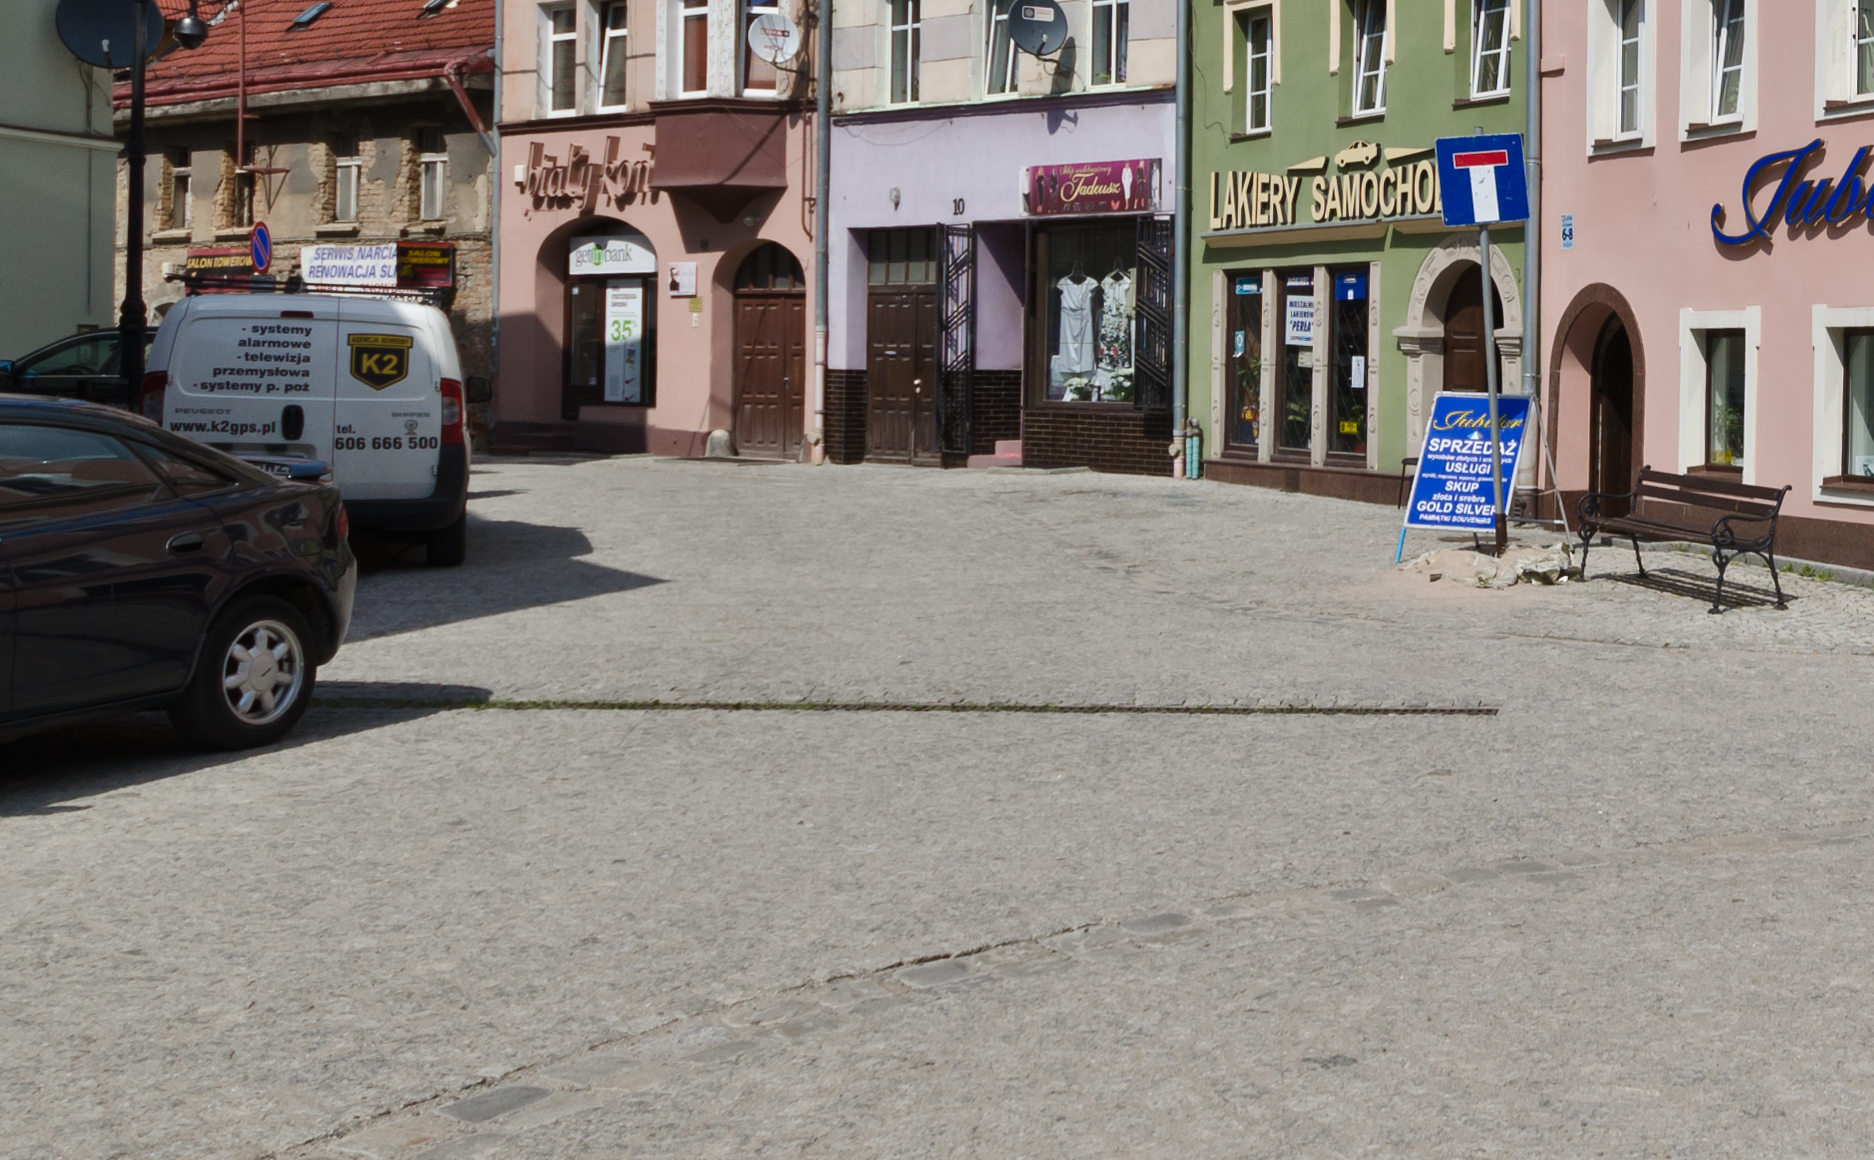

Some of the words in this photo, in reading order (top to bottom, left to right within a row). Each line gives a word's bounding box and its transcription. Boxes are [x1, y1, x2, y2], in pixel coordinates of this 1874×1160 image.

[1060, 172, 1121, 202] Tadeusz
[1210, 170, 1299, 230] LAKIERY
[953, 198, 965, 215] 10
[313, 247, 354, 261] SERWIS
[308, 264, 377, 278] RENOWACJA
[252, 325, 312, 336] systemy
[238, 338, 311, 349] alarmowe
[244, 352, 311, 365] telewizja
[361, 353, 398, 375] K2
[213, 367, 310, 378] przemysłowa
[200, 381, 261, 393] systemy
[266, 383, 280, 392] p.
[284, 381, 310, 393] poż
[170, 420, 276, 434] www.k2gps.pl
[336, 424, 356, 434] tel.
[335, 437, 365, 450] 606
[372, 437, 402, 450] 666
[408, 437, 438, 449] 500
[1445, 462, 1491, 474] USŁUGI
[1445, 480, 1479, 492] SKUP
[1459, 494, 1485, 503] srebra
[1416, 501, 1452, 513] GOLD
